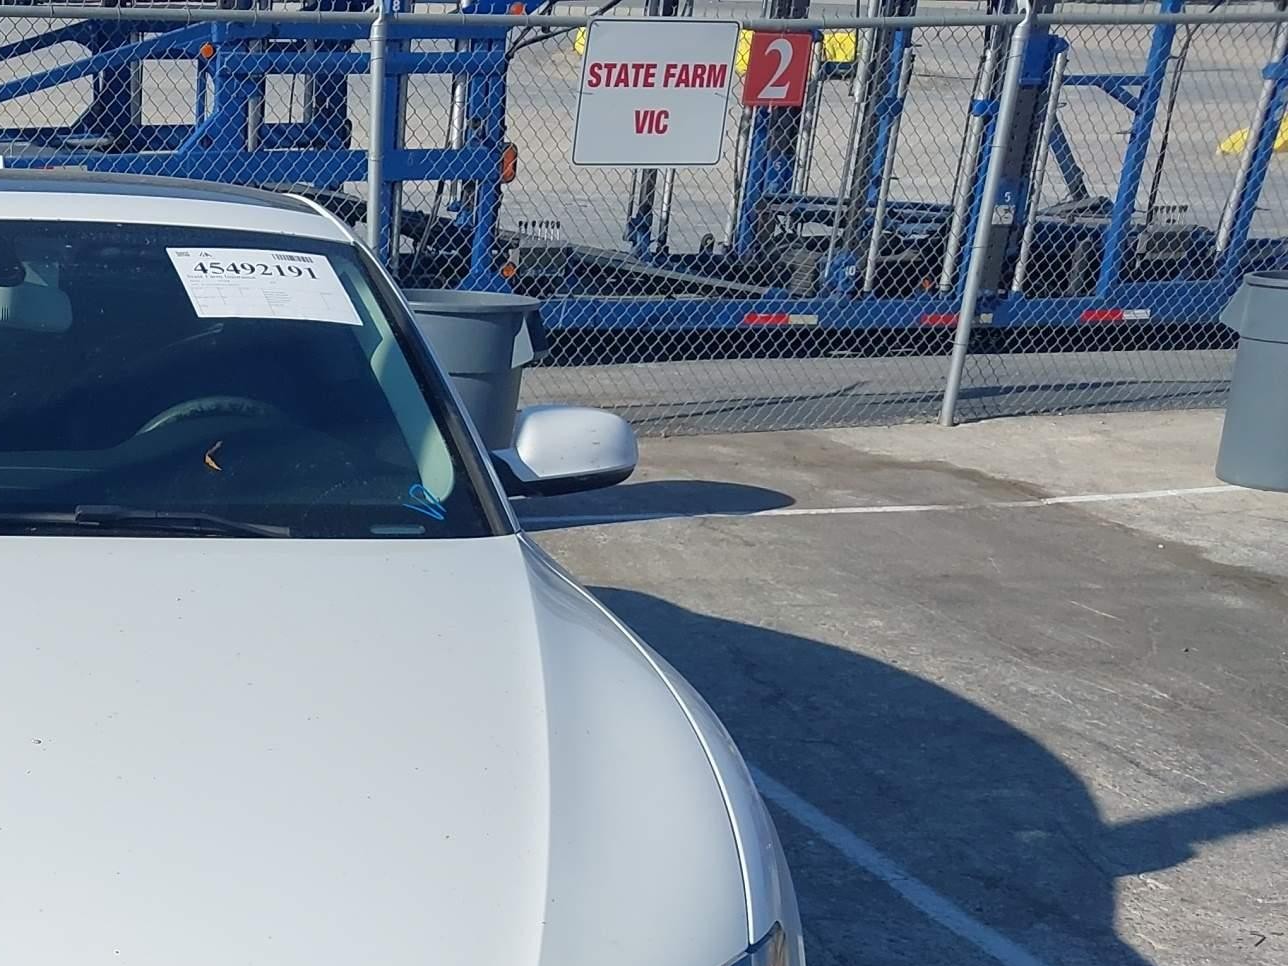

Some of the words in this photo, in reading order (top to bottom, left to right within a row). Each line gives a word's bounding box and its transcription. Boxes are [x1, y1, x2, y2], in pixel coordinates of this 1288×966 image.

[587, 62, 657, 88] STATE
[663, 63, 727, 88] FARM
[757, 38, 793, 99] 2
[634, 109, 670, 134] VIC
[193, 262, 318, 280] 45492191
